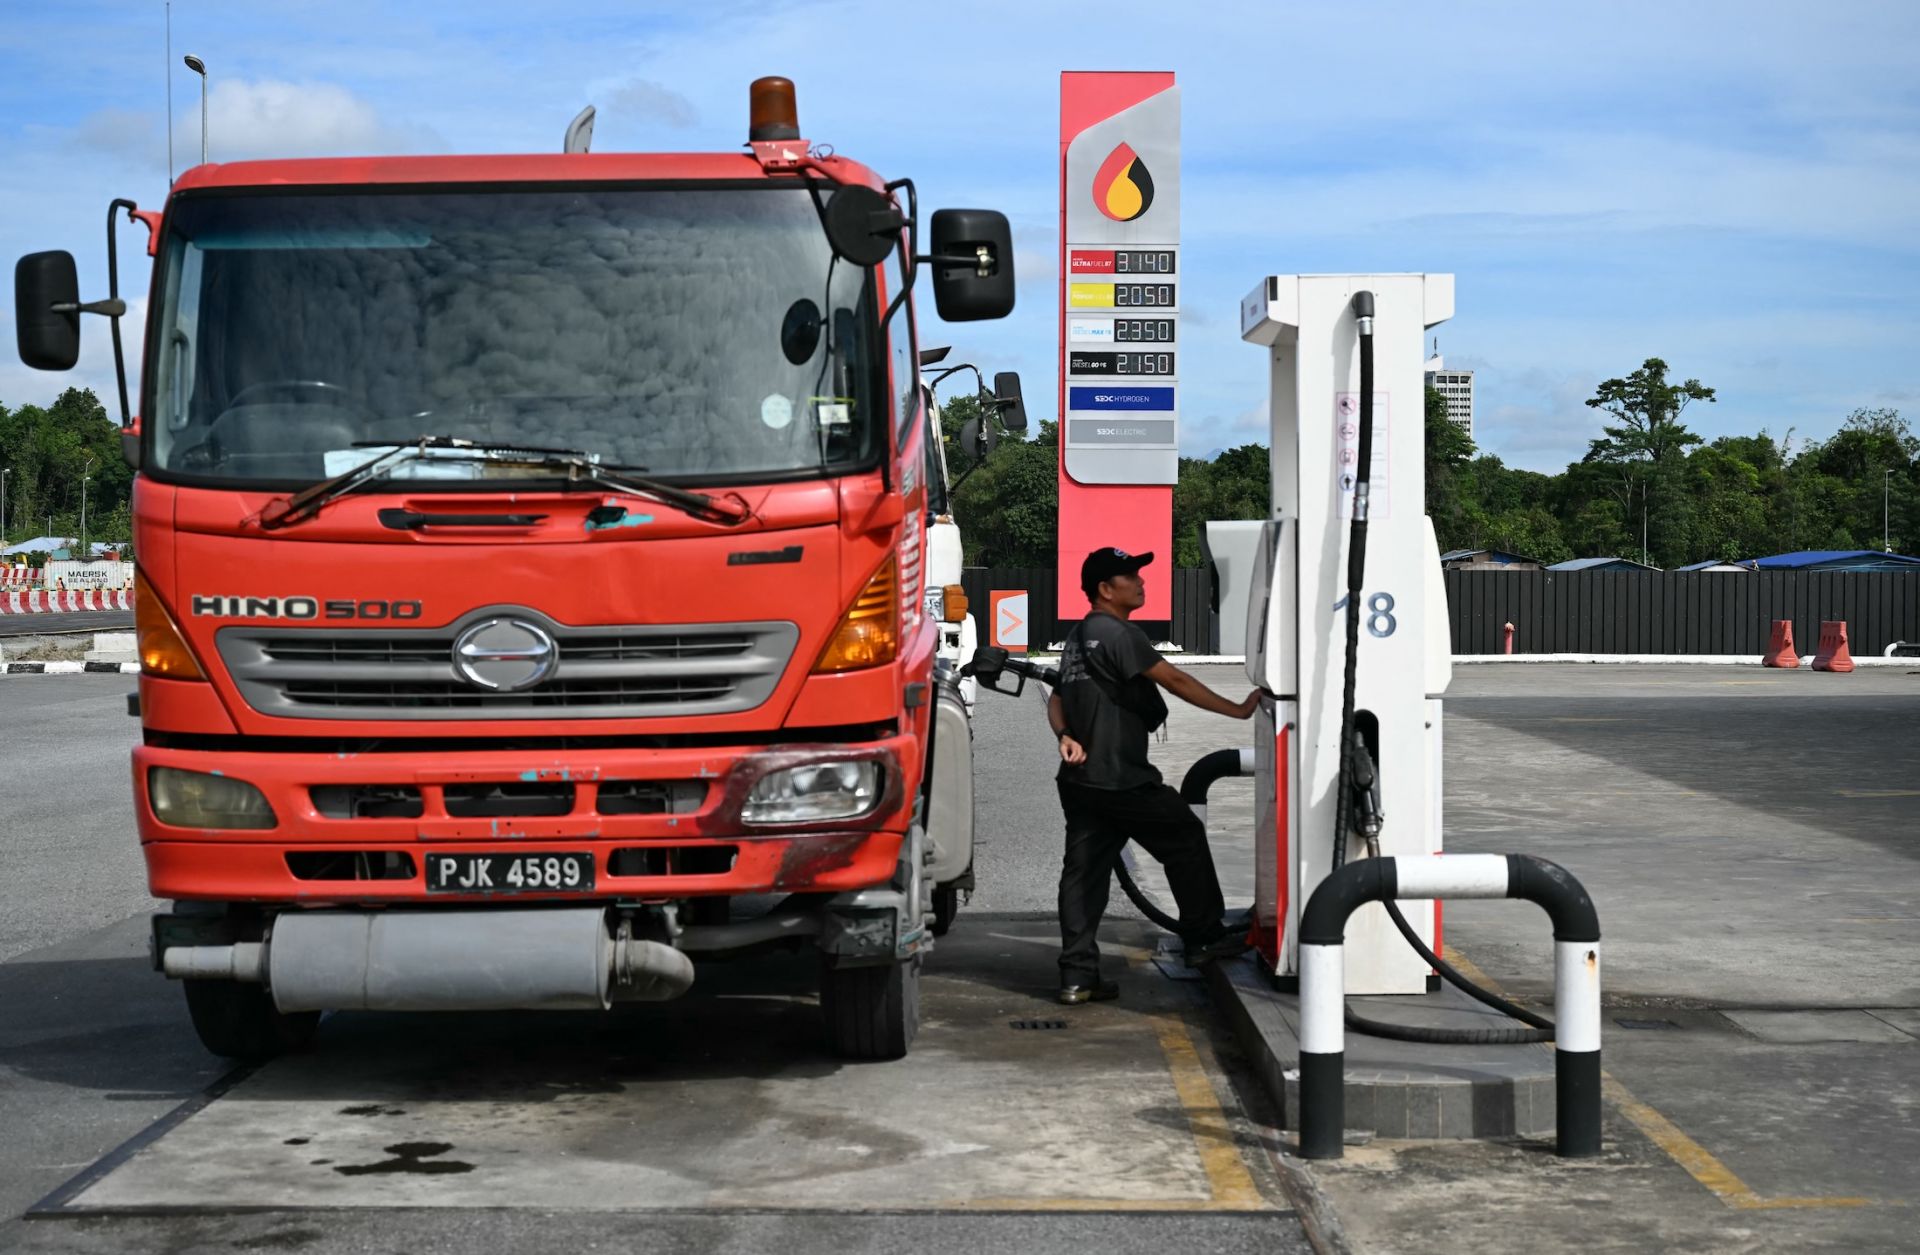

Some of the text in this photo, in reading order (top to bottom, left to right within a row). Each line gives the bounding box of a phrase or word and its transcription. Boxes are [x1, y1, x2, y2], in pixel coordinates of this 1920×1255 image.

[1118, 253, 1169, 272] 3.140
[1117, 286, 1169, 305] 2.050
[1117, 321, 1169, 340] 2.350
[1117, 354, 1168, 373] 2.150
[192, 594, 423, 619] HINO 500
[439, 857, 581, 888] PJK 4589
